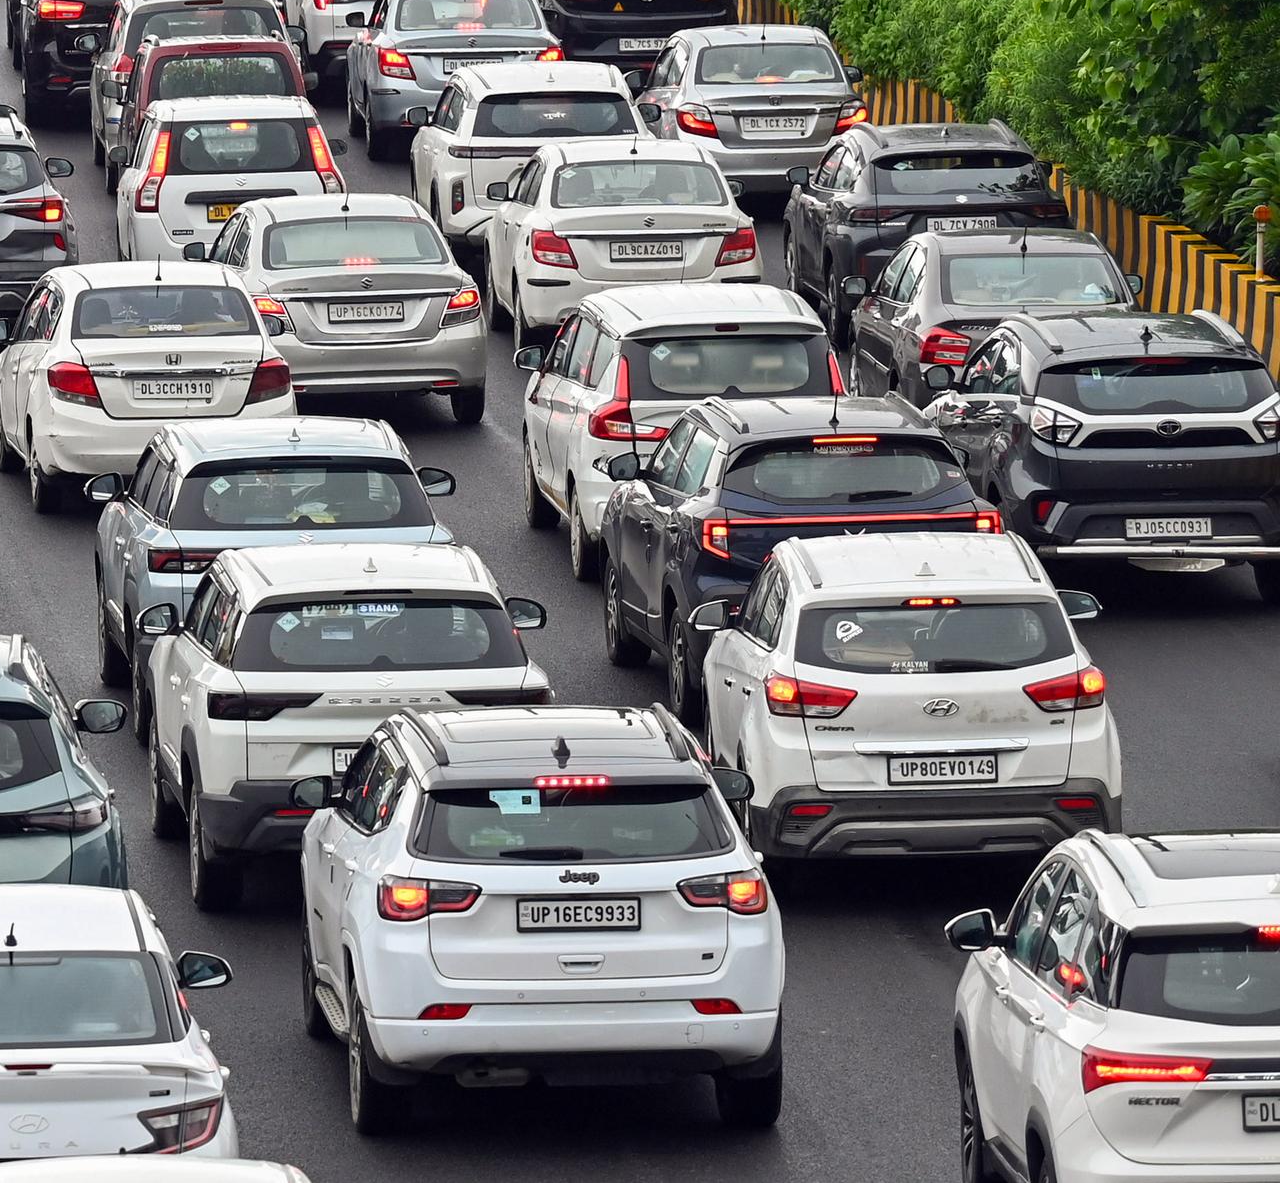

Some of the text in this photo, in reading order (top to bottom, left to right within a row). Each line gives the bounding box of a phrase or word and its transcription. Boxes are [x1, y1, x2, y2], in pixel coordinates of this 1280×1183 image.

[750, 117, 805, 130] DL 1CX 2572
[933, 219, 995, 231] DL 7CV 7908
[618, 244, 681, 256] DL9CAZ4019
[141, 382, 211, 395] DL3CCH1910
[1135, 520, 1210, 535] RJ05CC0931
[370, 604, 398, 613] RANA
[900, 761, 995, 777] UP80EV0149
[557, 869, 600, 886] Jeep
[531, 905, 637, 924] UP16EC9933
[1128, 1097, 1182, 1108] HECTOR
